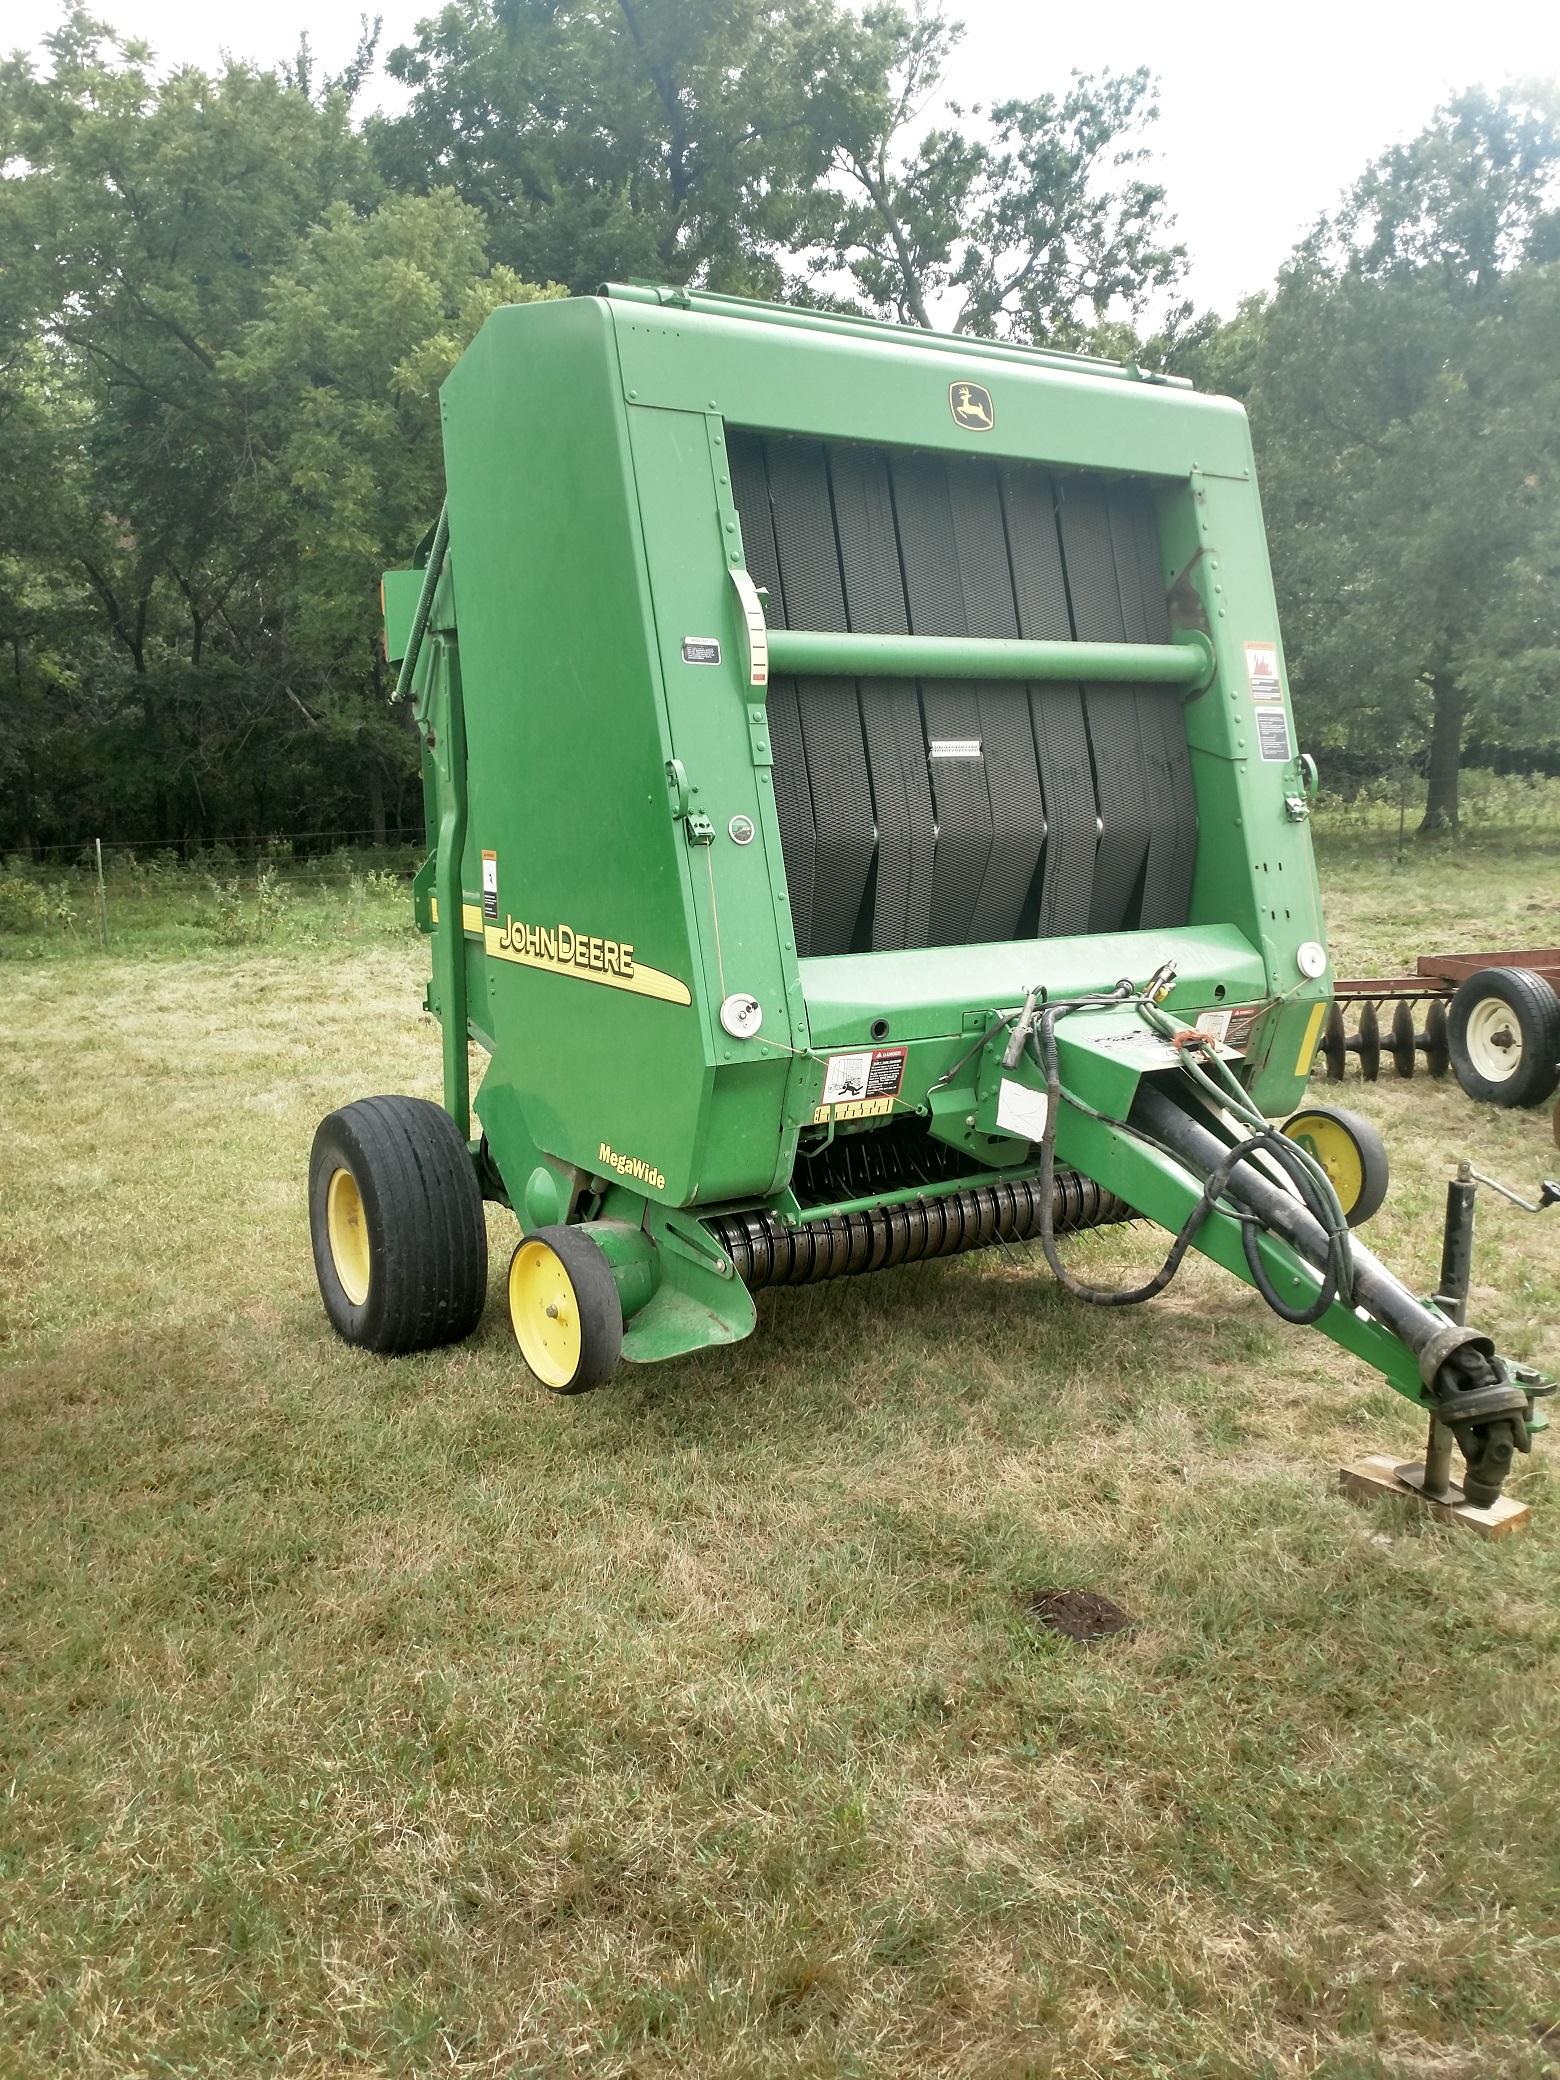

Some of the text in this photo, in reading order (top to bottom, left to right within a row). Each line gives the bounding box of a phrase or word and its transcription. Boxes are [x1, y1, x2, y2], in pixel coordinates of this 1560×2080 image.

[500, 914, 634, 978] JOHN DEERE
[599, 1142, 666, 1190] MegaWide
